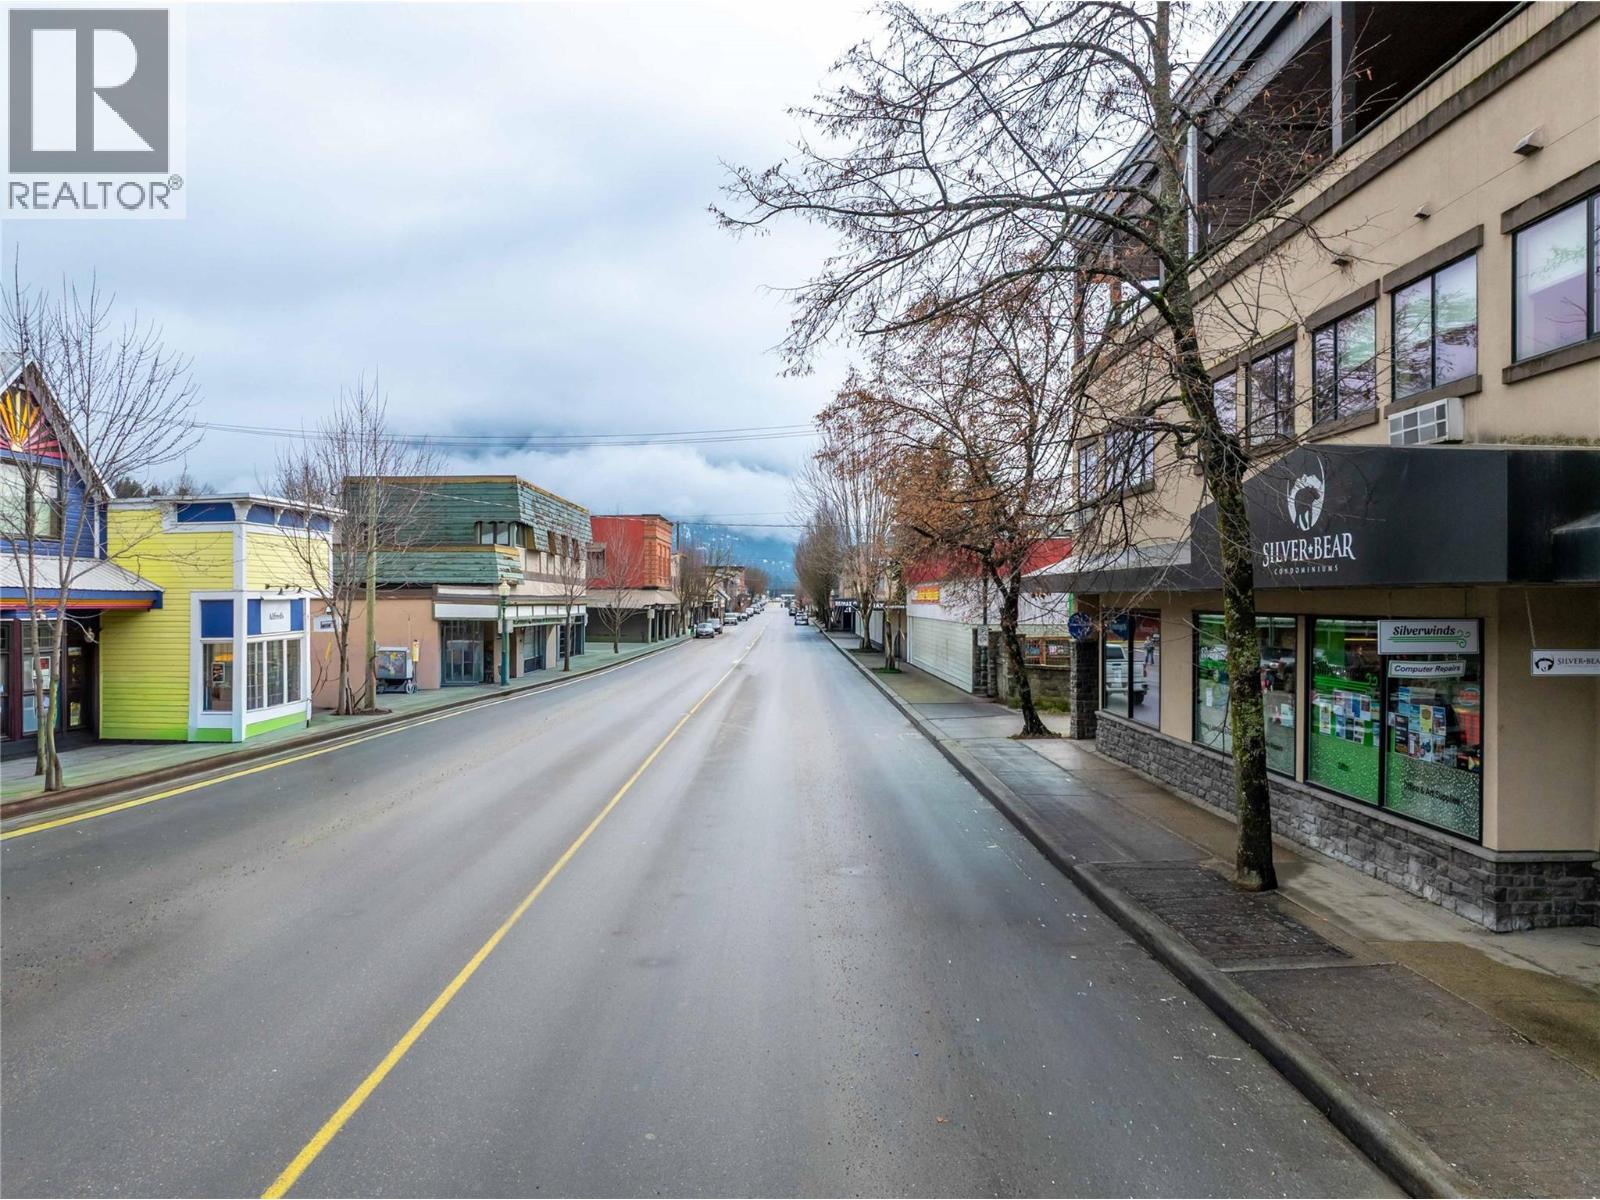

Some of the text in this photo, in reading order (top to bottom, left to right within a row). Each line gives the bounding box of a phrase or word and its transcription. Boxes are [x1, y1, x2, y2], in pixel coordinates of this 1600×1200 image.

[1393, 625, 1456, 636] Silverwinds
[1586, 657, 1600, 665] BEA
[1394, 664, 1460, 674] Computer Repairs
